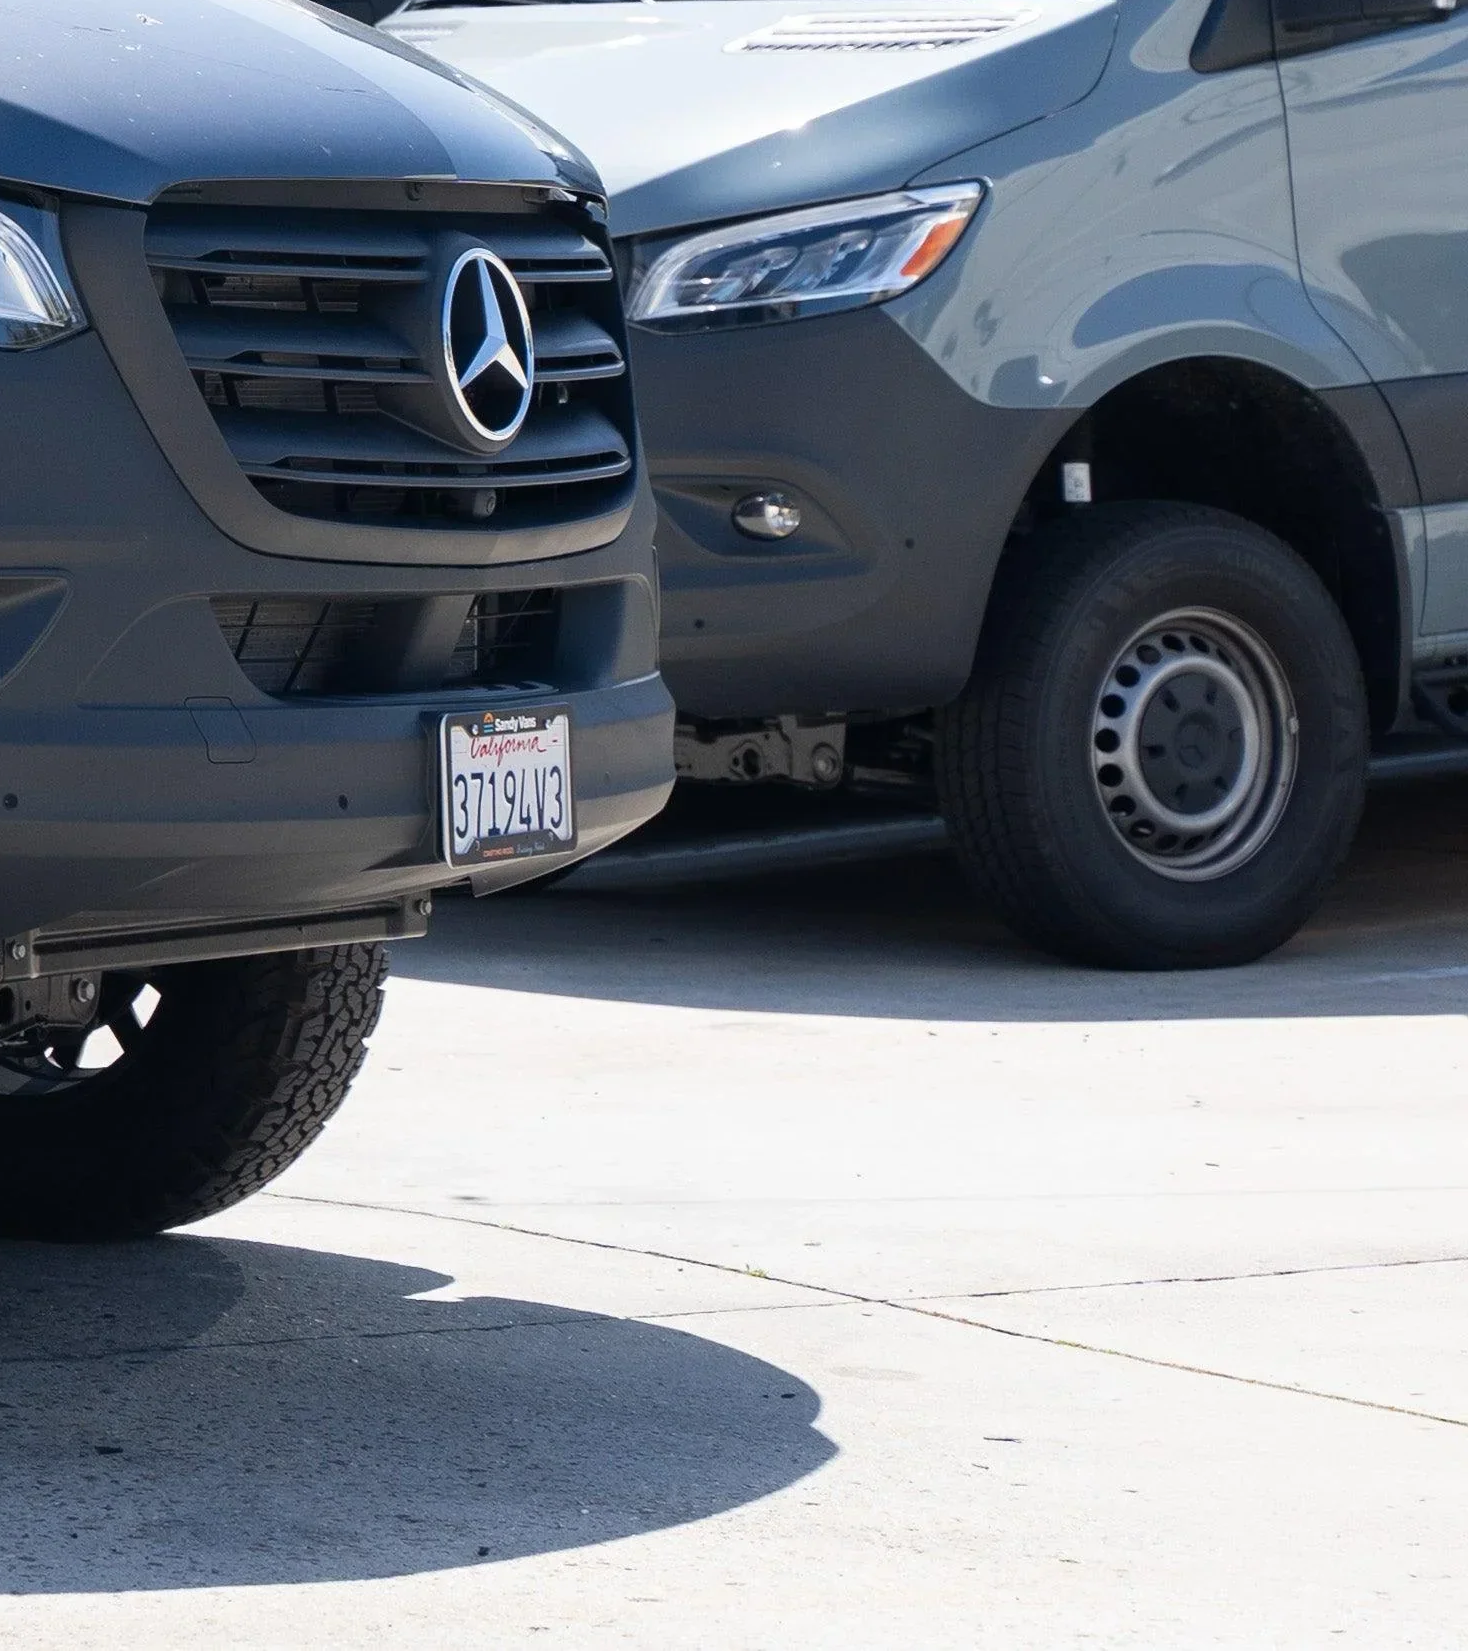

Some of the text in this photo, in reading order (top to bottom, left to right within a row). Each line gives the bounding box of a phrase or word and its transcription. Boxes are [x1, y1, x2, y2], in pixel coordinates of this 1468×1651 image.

[494, 715, 537, 732] Sandy Vans
[470, 732, 547, 768] California
[453, 764, 564, 840] 37194V3
